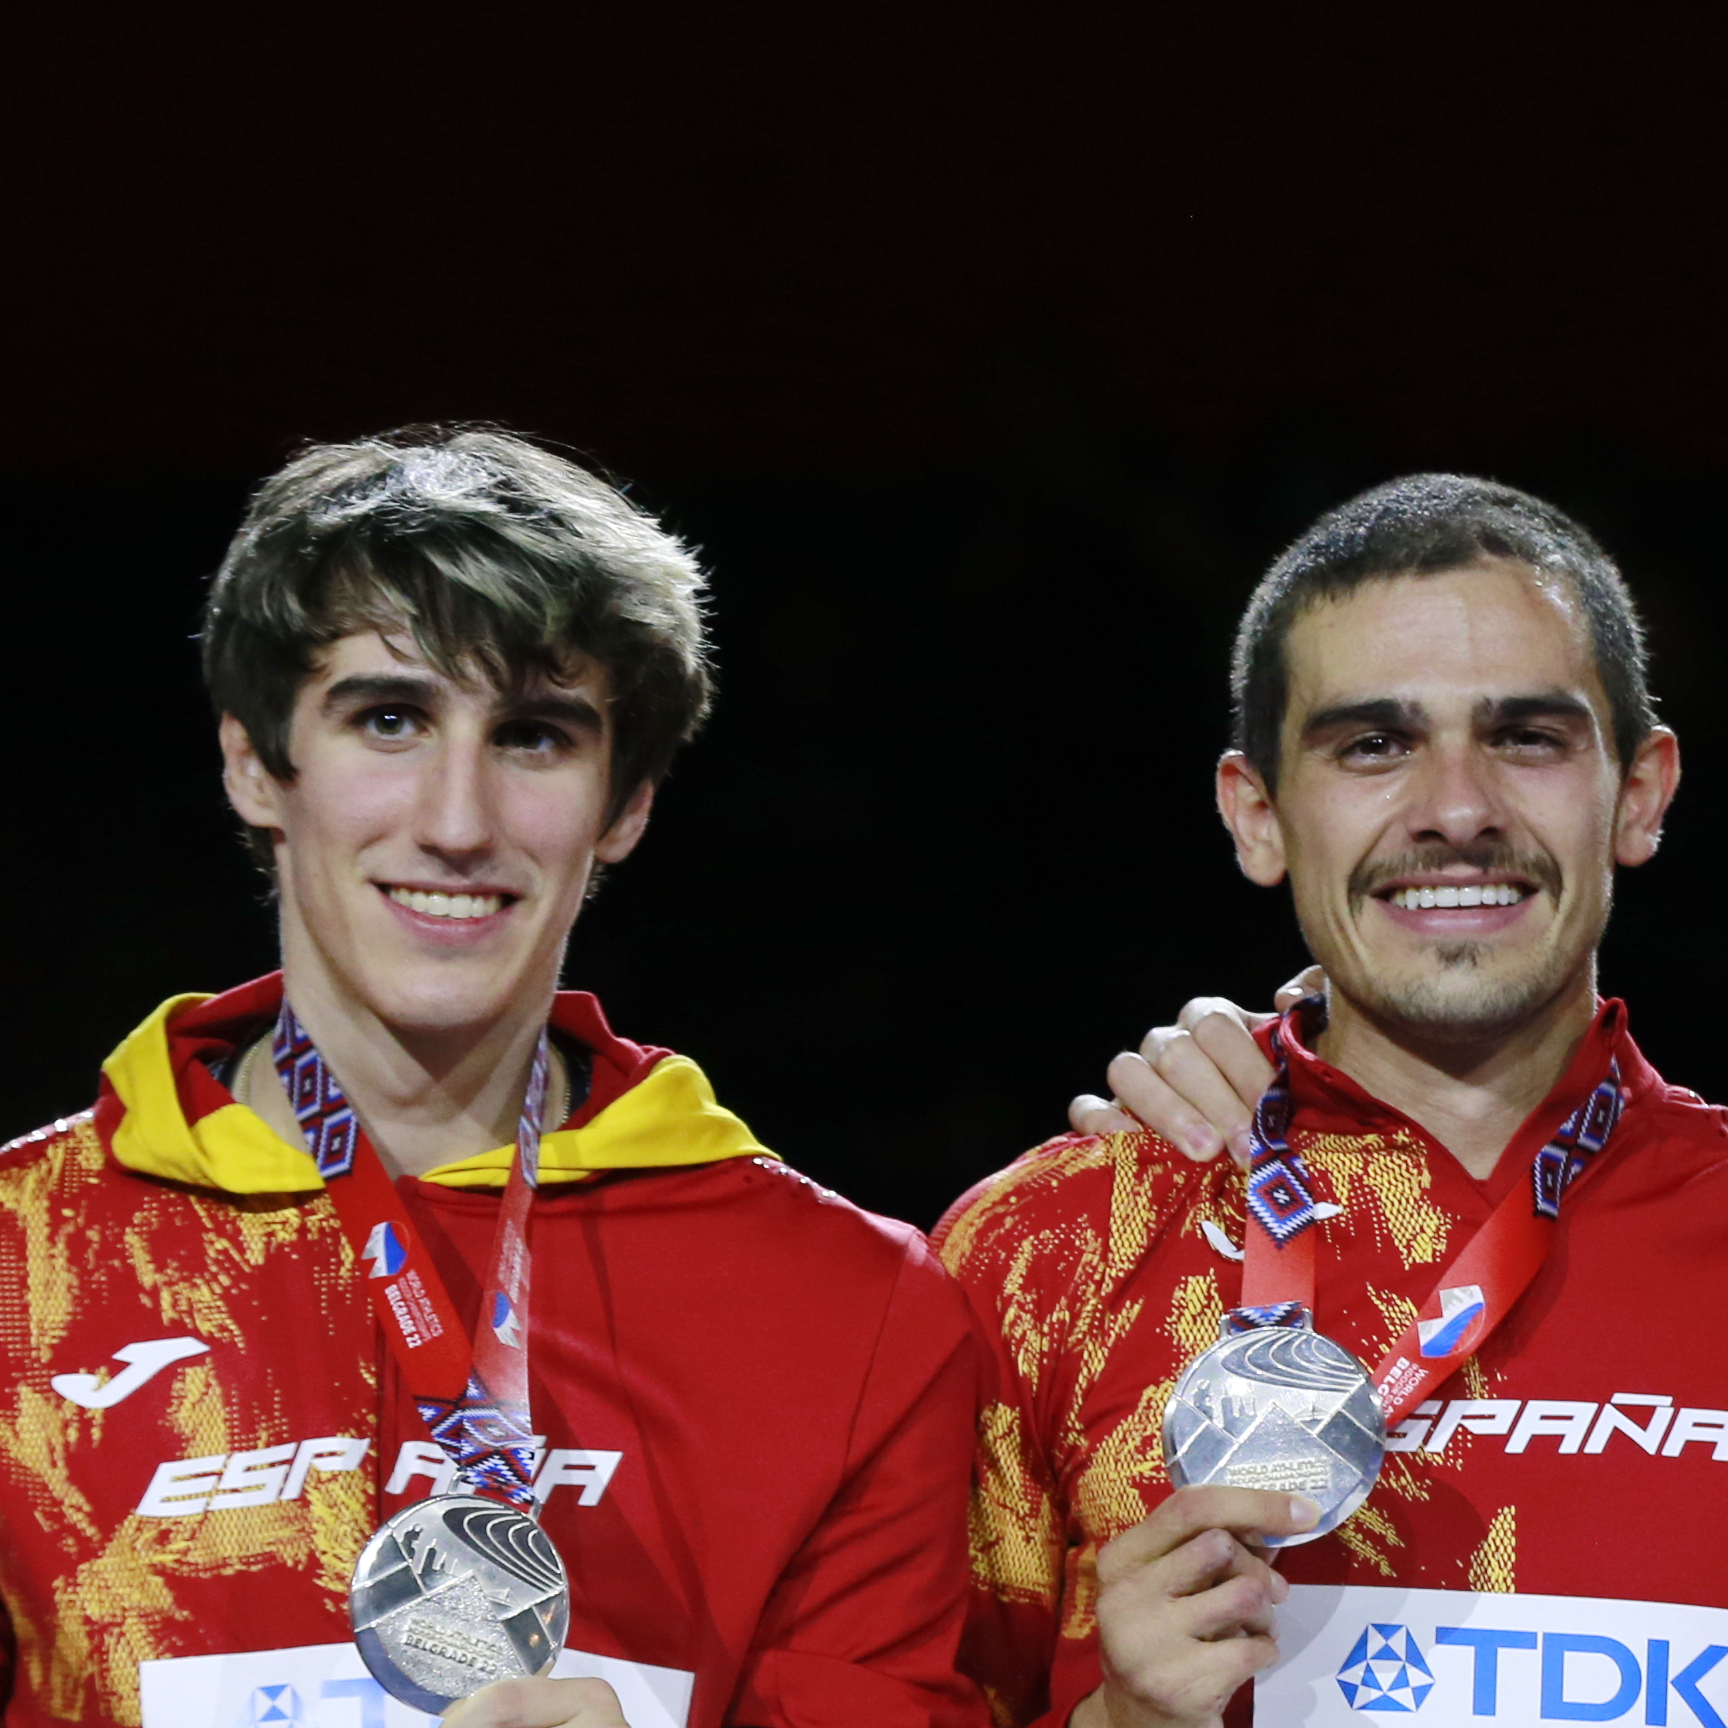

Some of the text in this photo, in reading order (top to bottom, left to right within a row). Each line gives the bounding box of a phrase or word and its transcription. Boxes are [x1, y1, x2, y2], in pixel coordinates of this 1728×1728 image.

[384, 1283, 417, 1337] BELGRADE
[405, 1333, 423, 1349] 22
[1377, 1356, 1410, 1400] BELG
[1393, 1368, 1429, 1405] WORLD
[401, 1632, 478, 1668] BELGRADE
